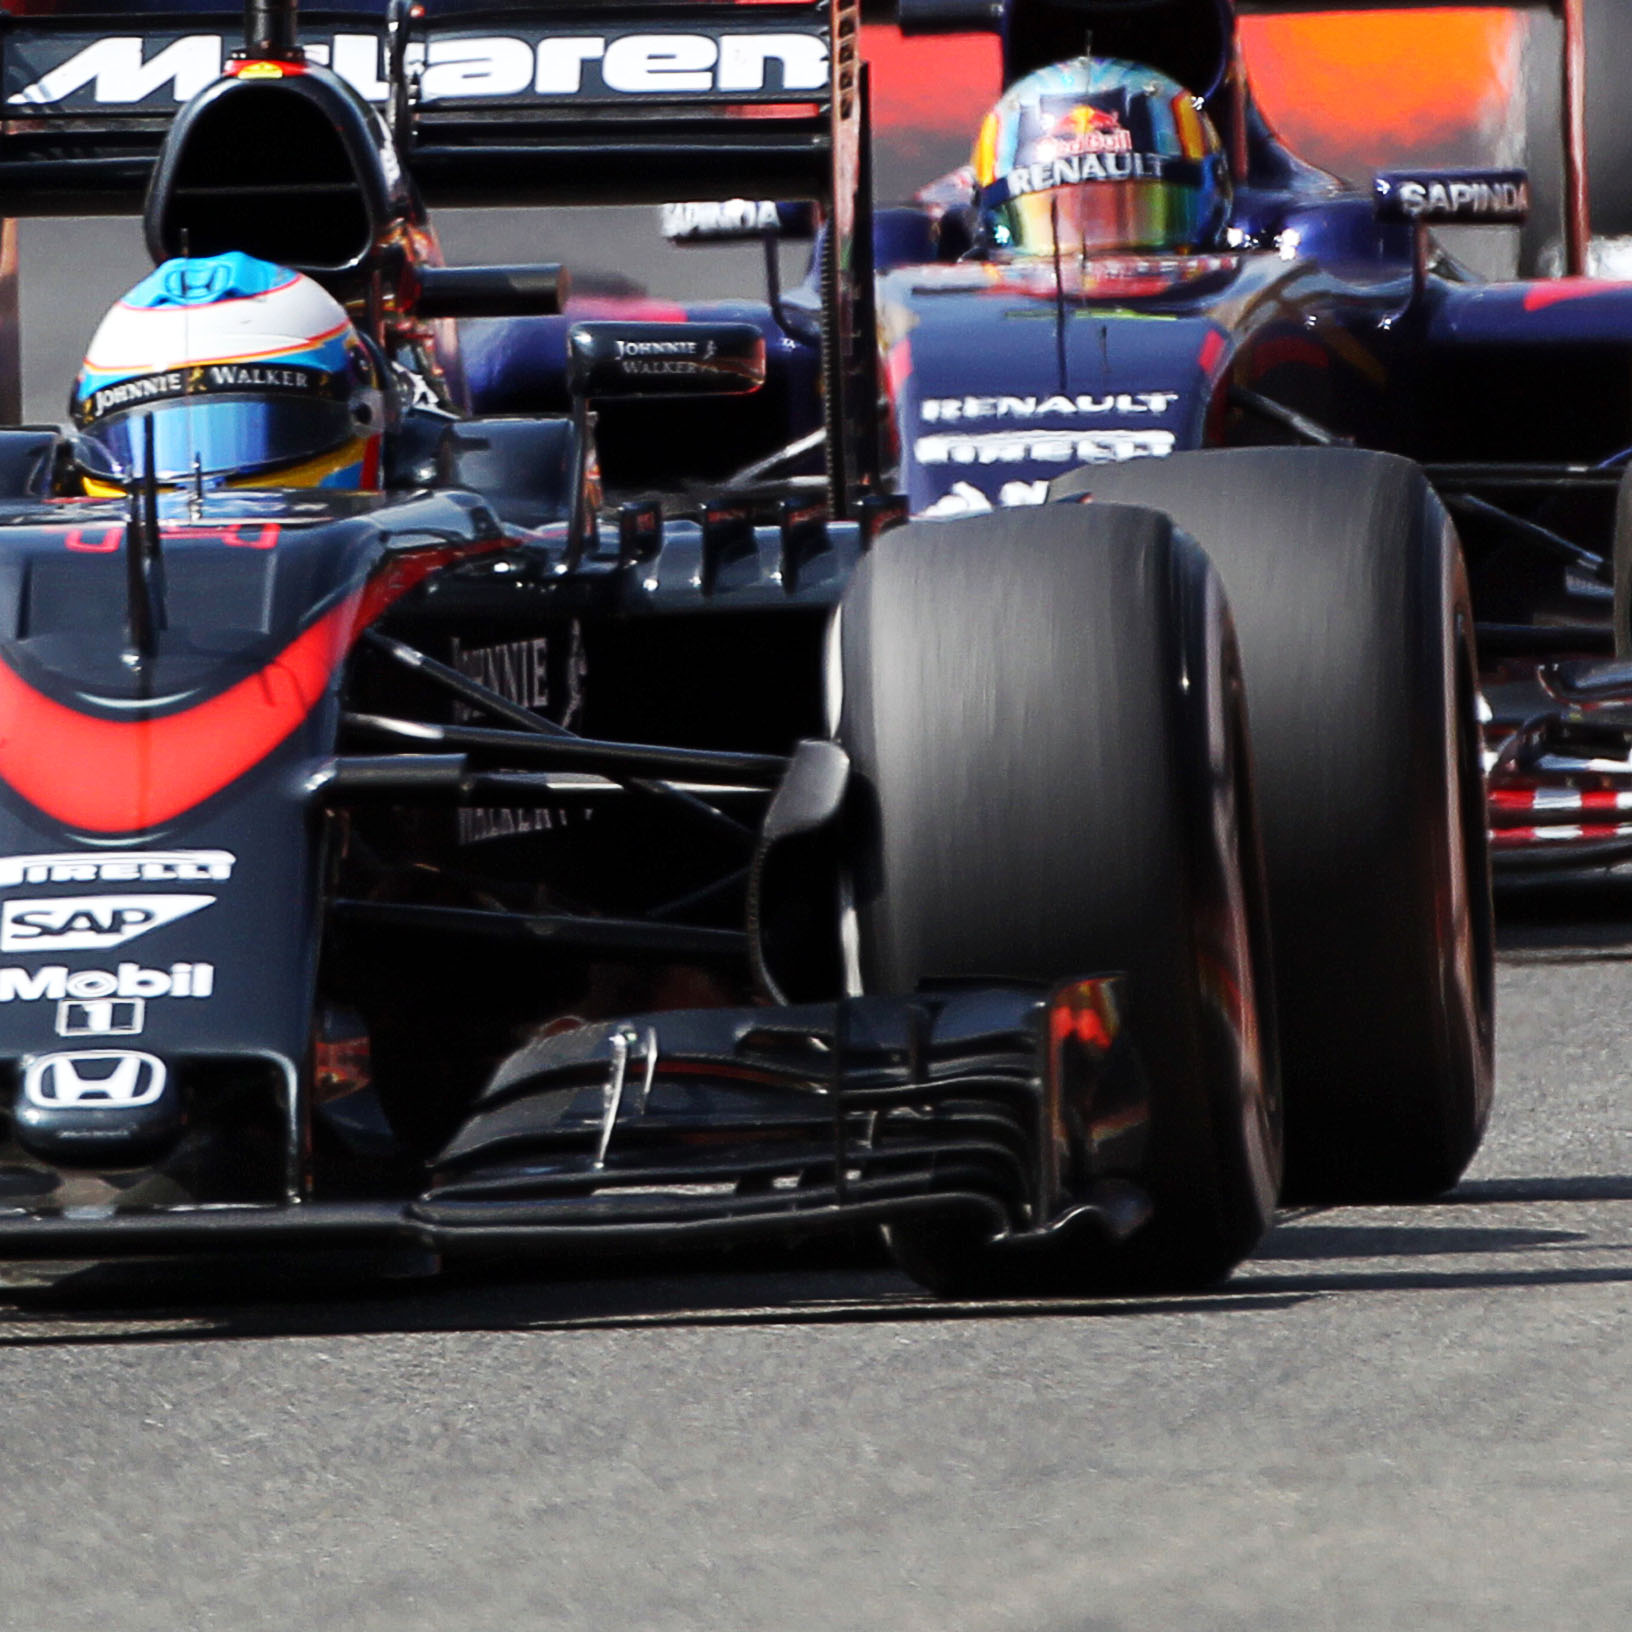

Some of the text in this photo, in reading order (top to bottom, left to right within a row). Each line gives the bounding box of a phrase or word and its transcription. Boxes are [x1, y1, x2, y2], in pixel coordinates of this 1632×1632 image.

[1084, 129, 1132, 155] Bull
[1007, 152, 1162, 195] RENAULT
[615, 340, 697, 360] JOHNNIE
[622, 361, 698, 374] WALKER
[95, 366, 308, 417] JOHNNIE WALKER
[921, 393, 1179, 421] RENAULT
[10, 907, 156, 939] SAP
